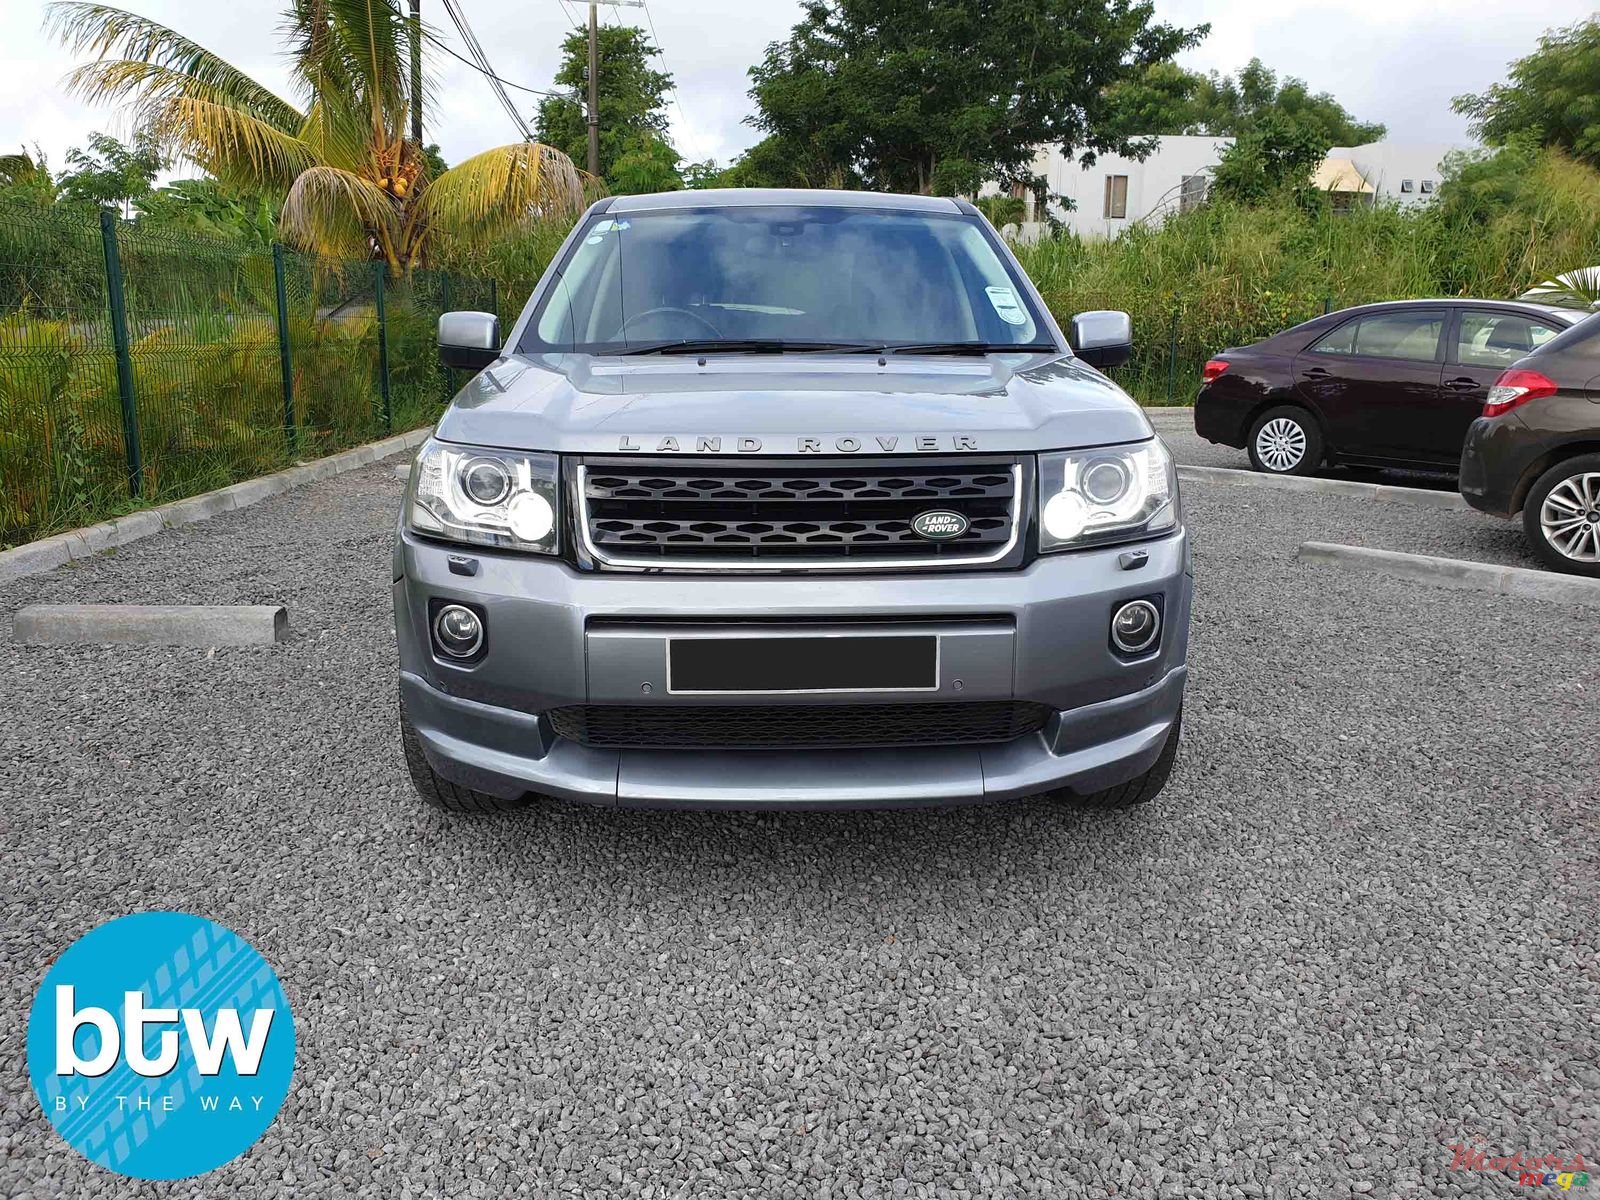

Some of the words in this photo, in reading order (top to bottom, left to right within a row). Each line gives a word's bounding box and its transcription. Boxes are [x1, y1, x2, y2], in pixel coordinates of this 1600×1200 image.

[618, 435, 763, 452] LAND
[797, 434, 979, 452] ROVER
[925, 516, 951, 525] LAND
[927, 524, 960, 533] ROVER
